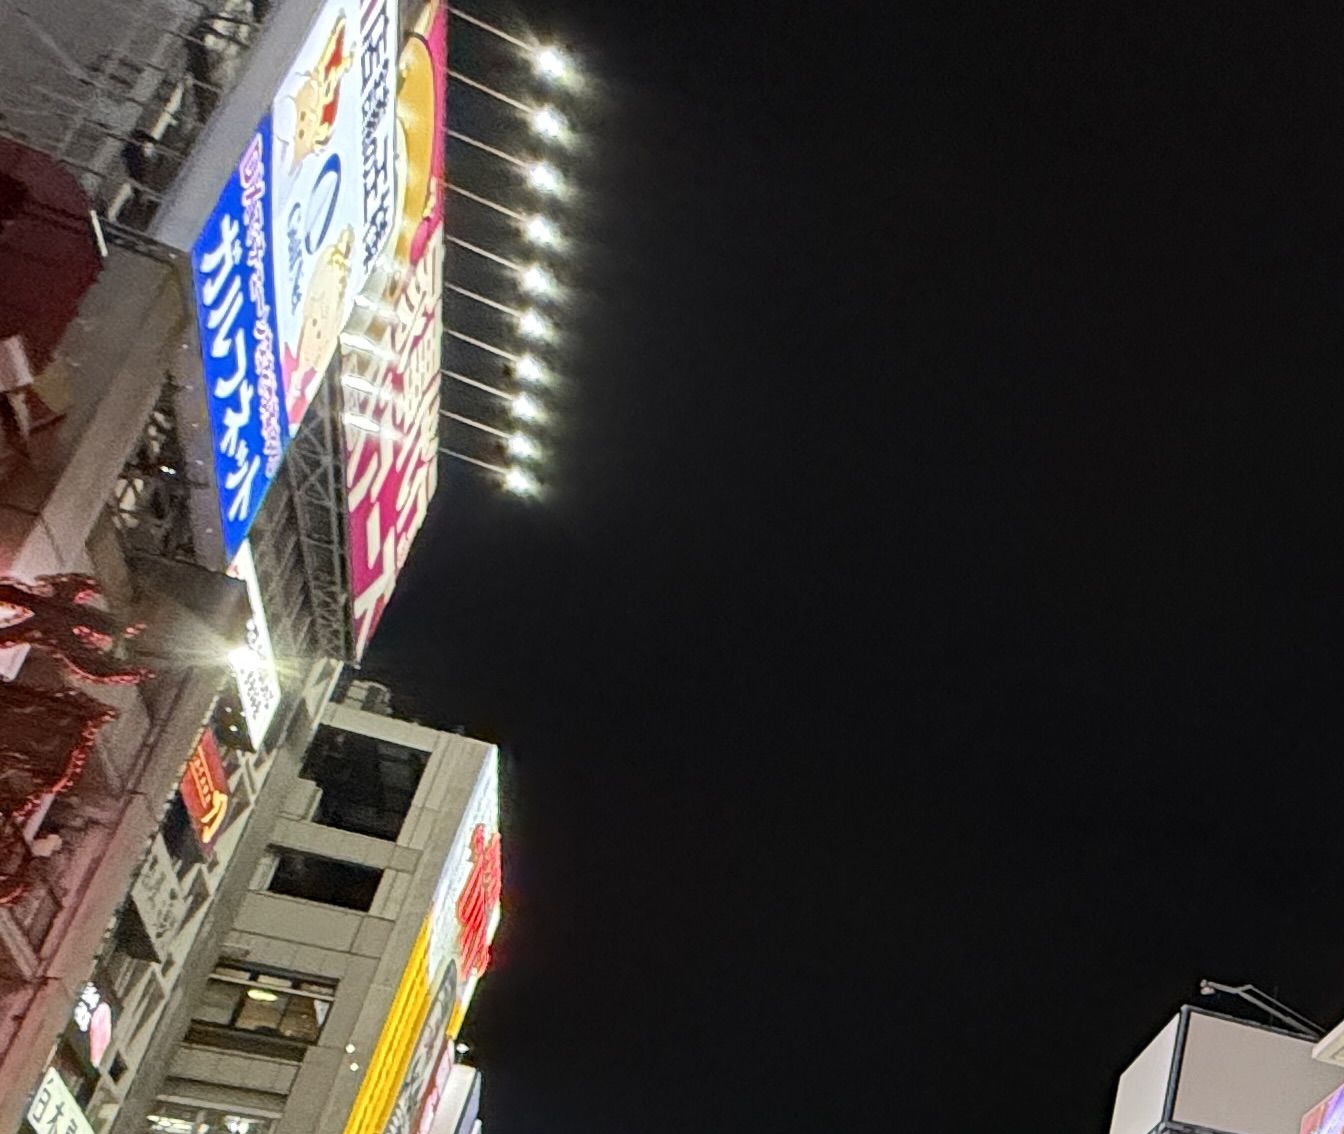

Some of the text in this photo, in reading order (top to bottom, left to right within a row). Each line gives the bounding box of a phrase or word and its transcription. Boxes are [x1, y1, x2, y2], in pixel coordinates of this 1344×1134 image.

[201, 212, 262, 524] ガルフネット
